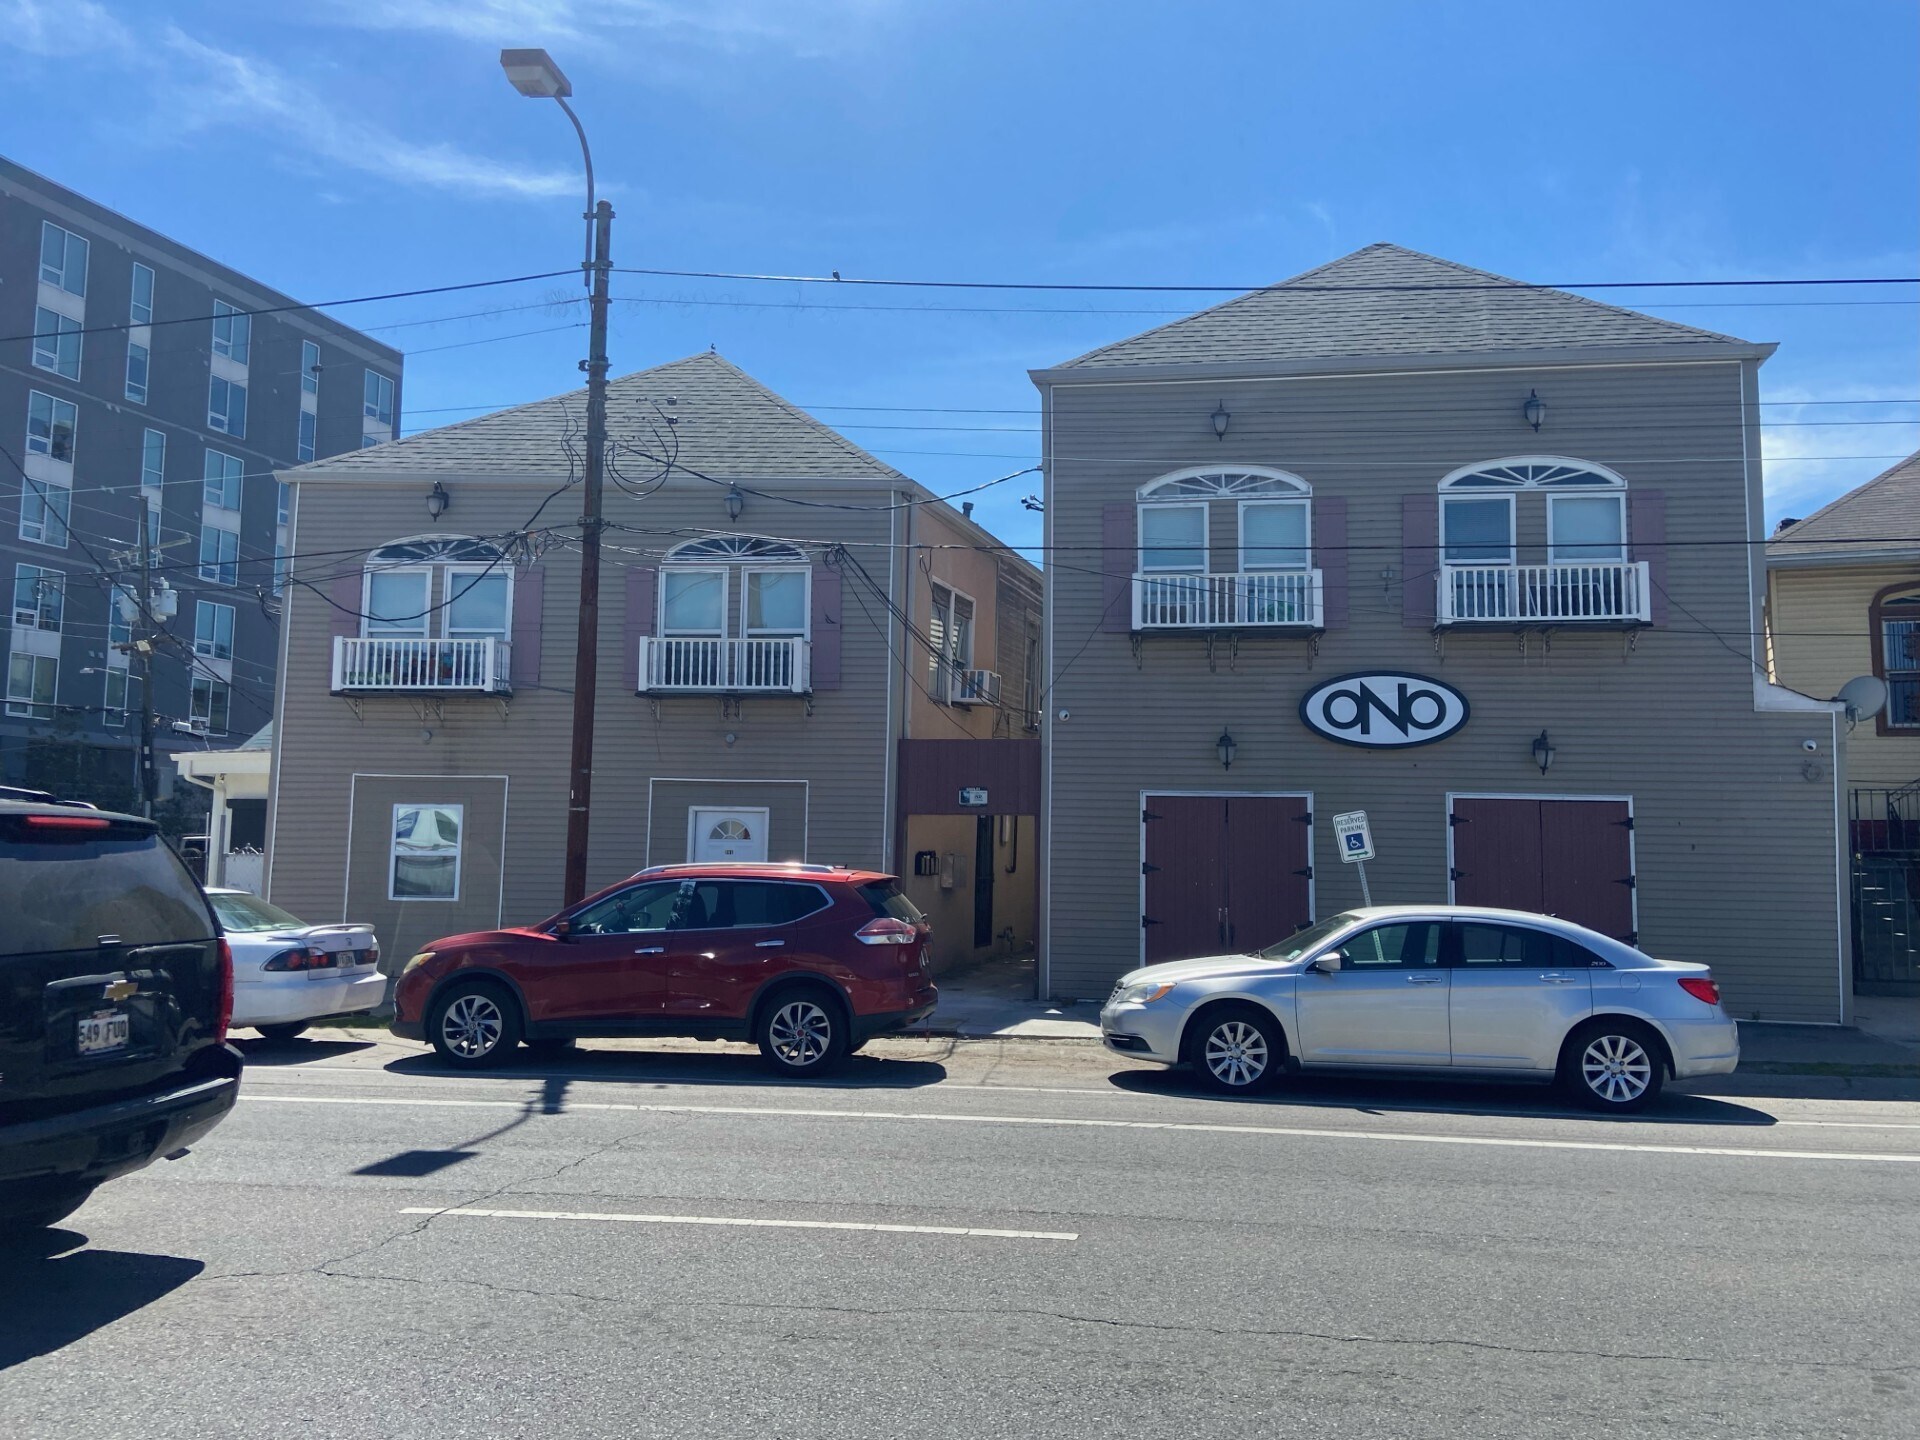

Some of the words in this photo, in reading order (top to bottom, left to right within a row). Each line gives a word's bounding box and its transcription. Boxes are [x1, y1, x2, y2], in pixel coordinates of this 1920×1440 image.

[1323, 681, 1446, 737] ONO
[1337, 815, 1365, 826] RESERVED
[1340, 823, 1365, 833] PARKING
[79, 1024, 100, 1045] 549
